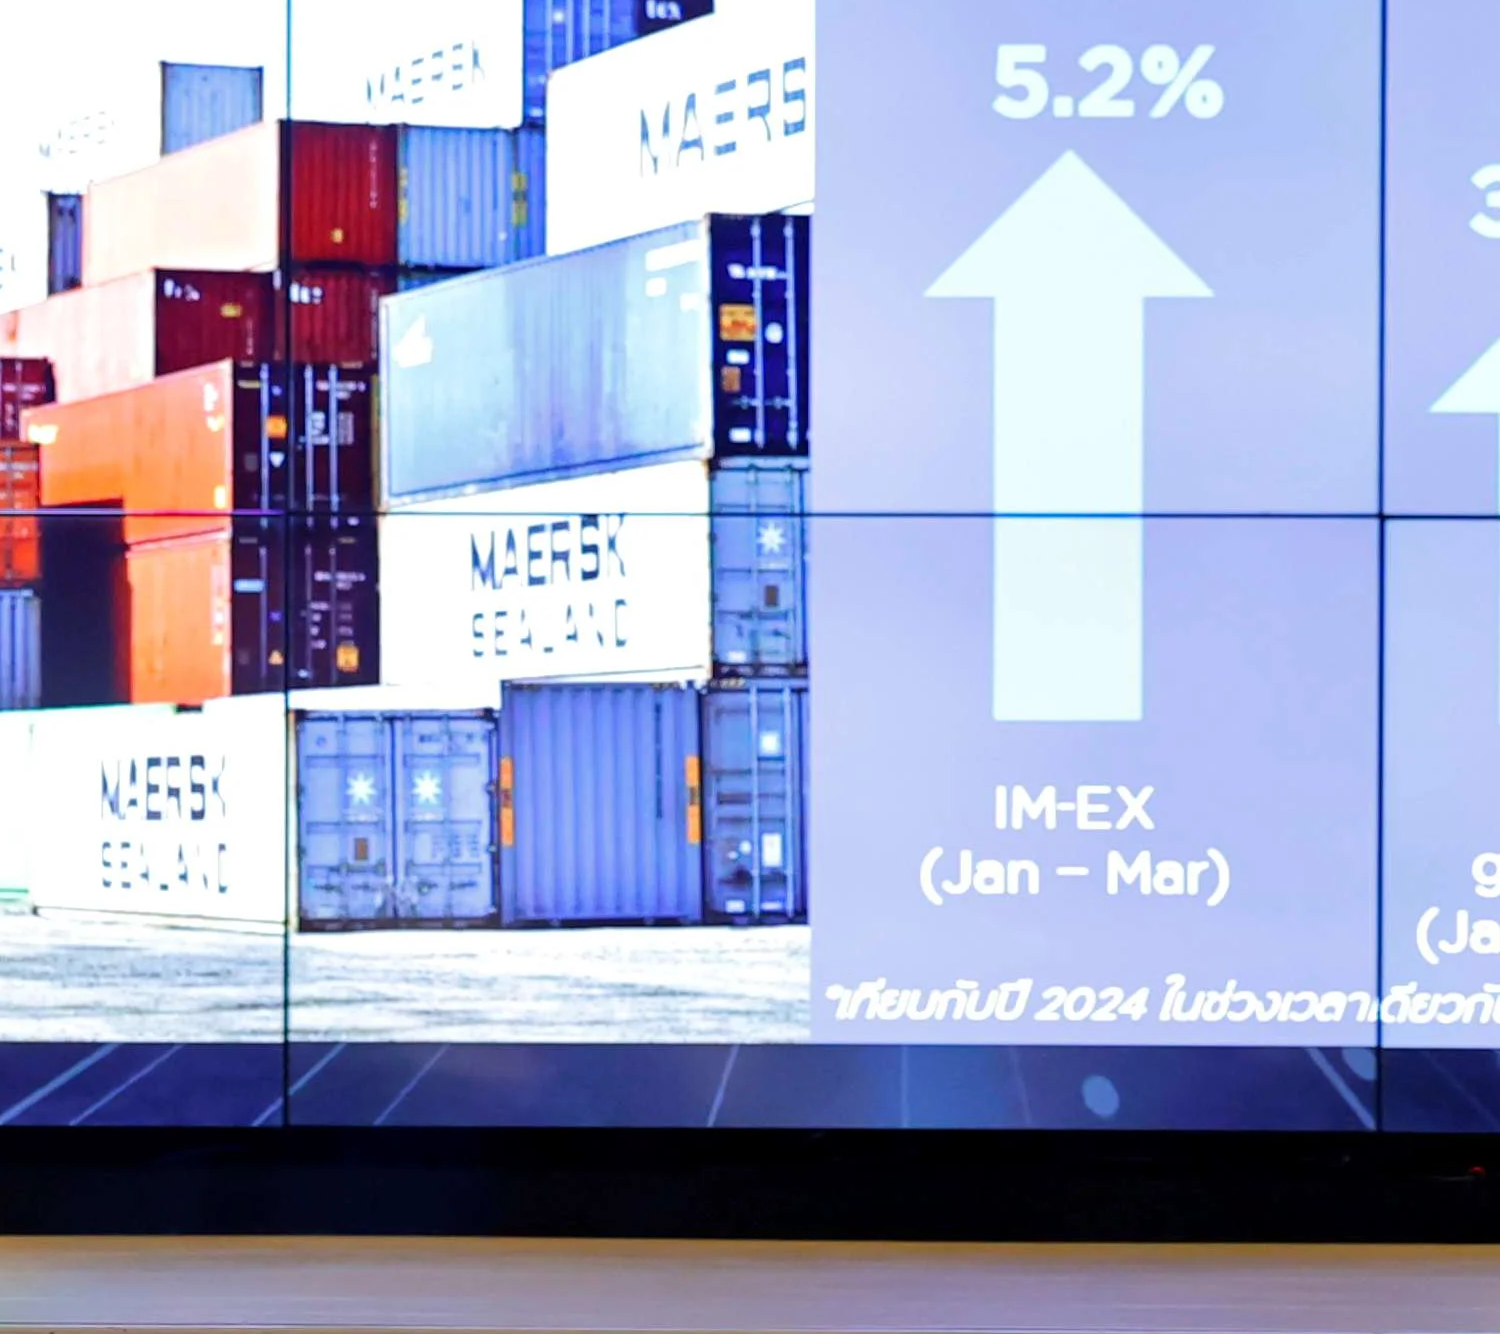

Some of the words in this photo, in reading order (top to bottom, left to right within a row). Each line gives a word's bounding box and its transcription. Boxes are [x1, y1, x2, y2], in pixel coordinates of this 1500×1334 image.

[994, 44, 1224, 119] 5.2%
[470, 512, 628, 591] MAERSK
[994, 784, 1155, 831] IM-EX
[918, 845, 1041, 907] (Jan
[1106, 847, 1231, 907] Mar)
[1035, 984, 1149, 1023] 2024
